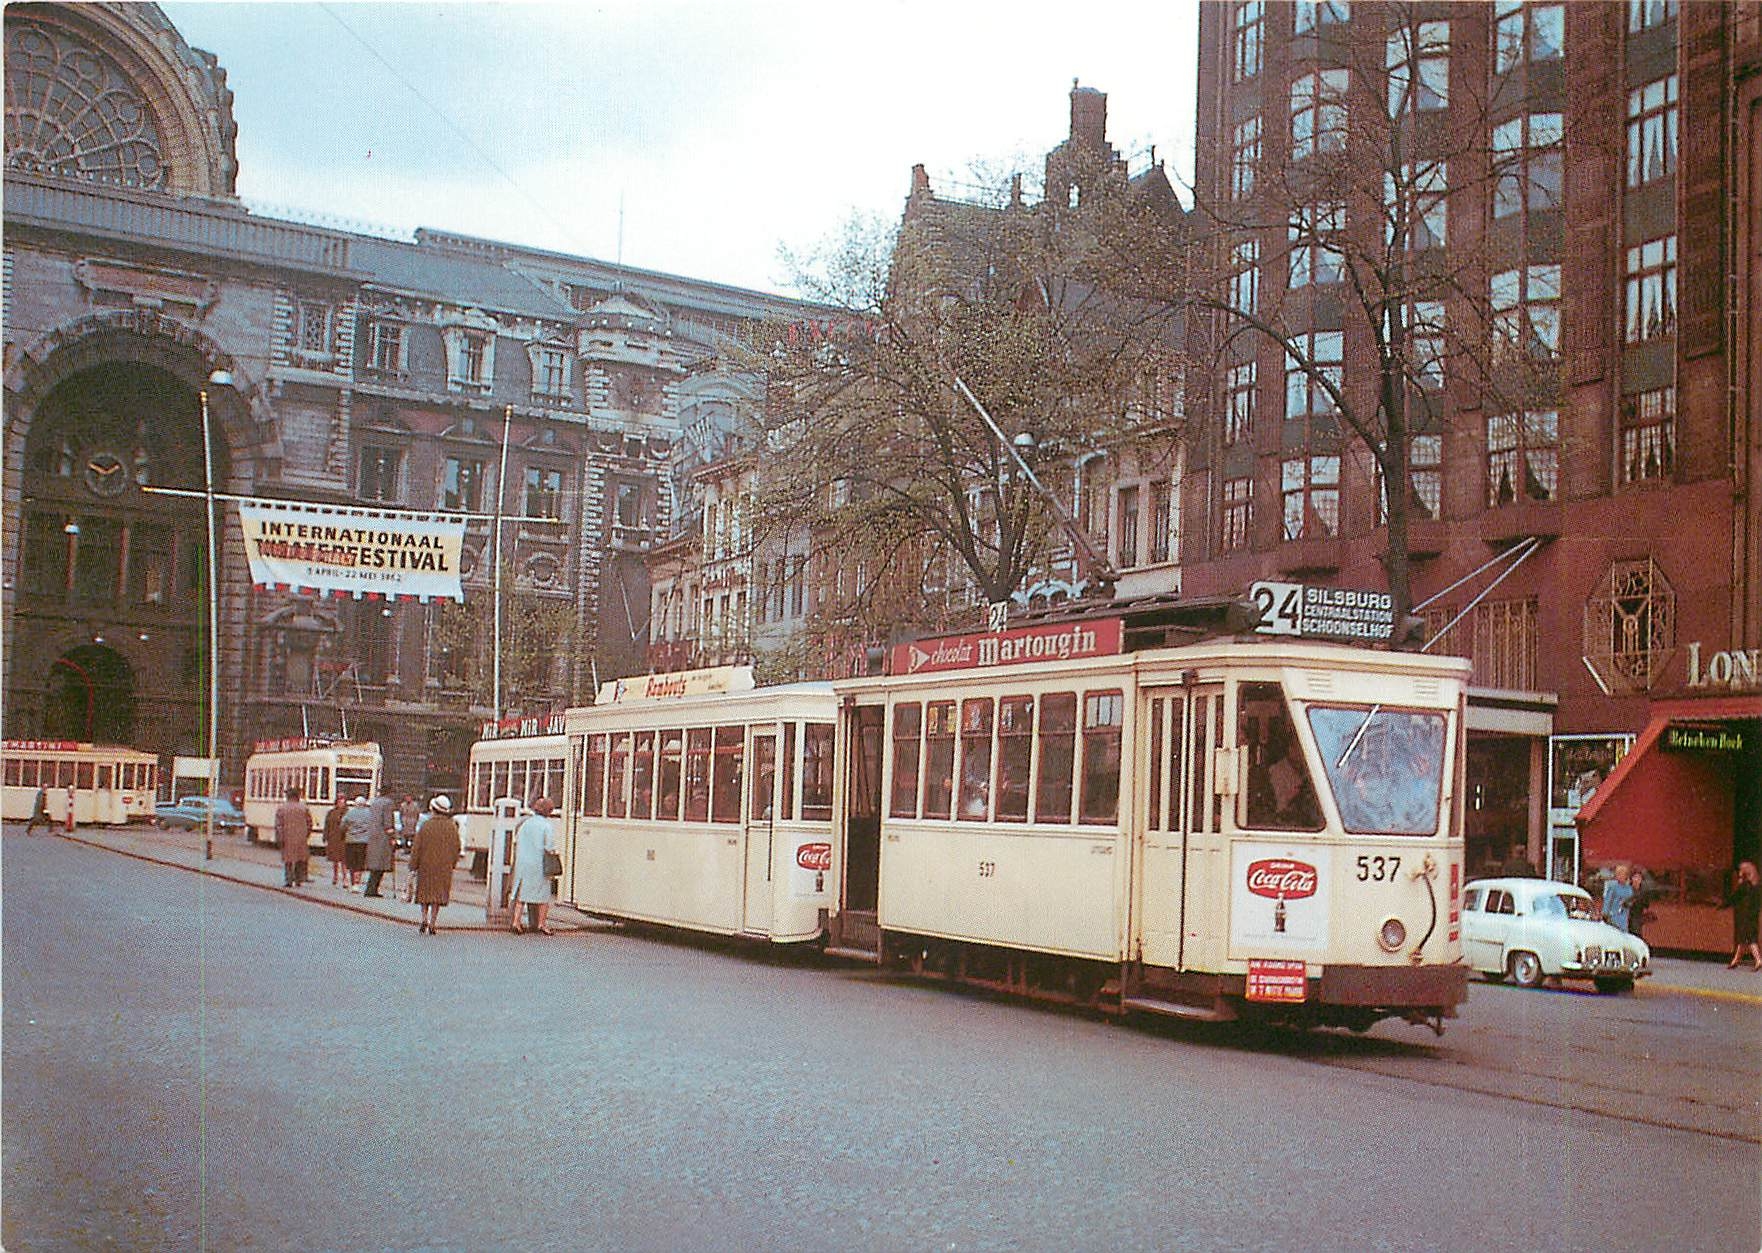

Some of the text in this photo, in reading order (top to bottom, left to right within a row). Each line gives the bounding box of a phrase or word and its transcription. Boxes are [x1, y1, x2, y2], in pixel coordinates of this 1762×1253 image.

[261, 520, 444, 549] INTERNATIONAAL
[1254, 587, 1298, 629] 24
[1306, 588, 1392, 609] SILSBURG
[1249, 868, 1315, 891] Coca-Cola
[1357, 856, 1401, 882] 537
